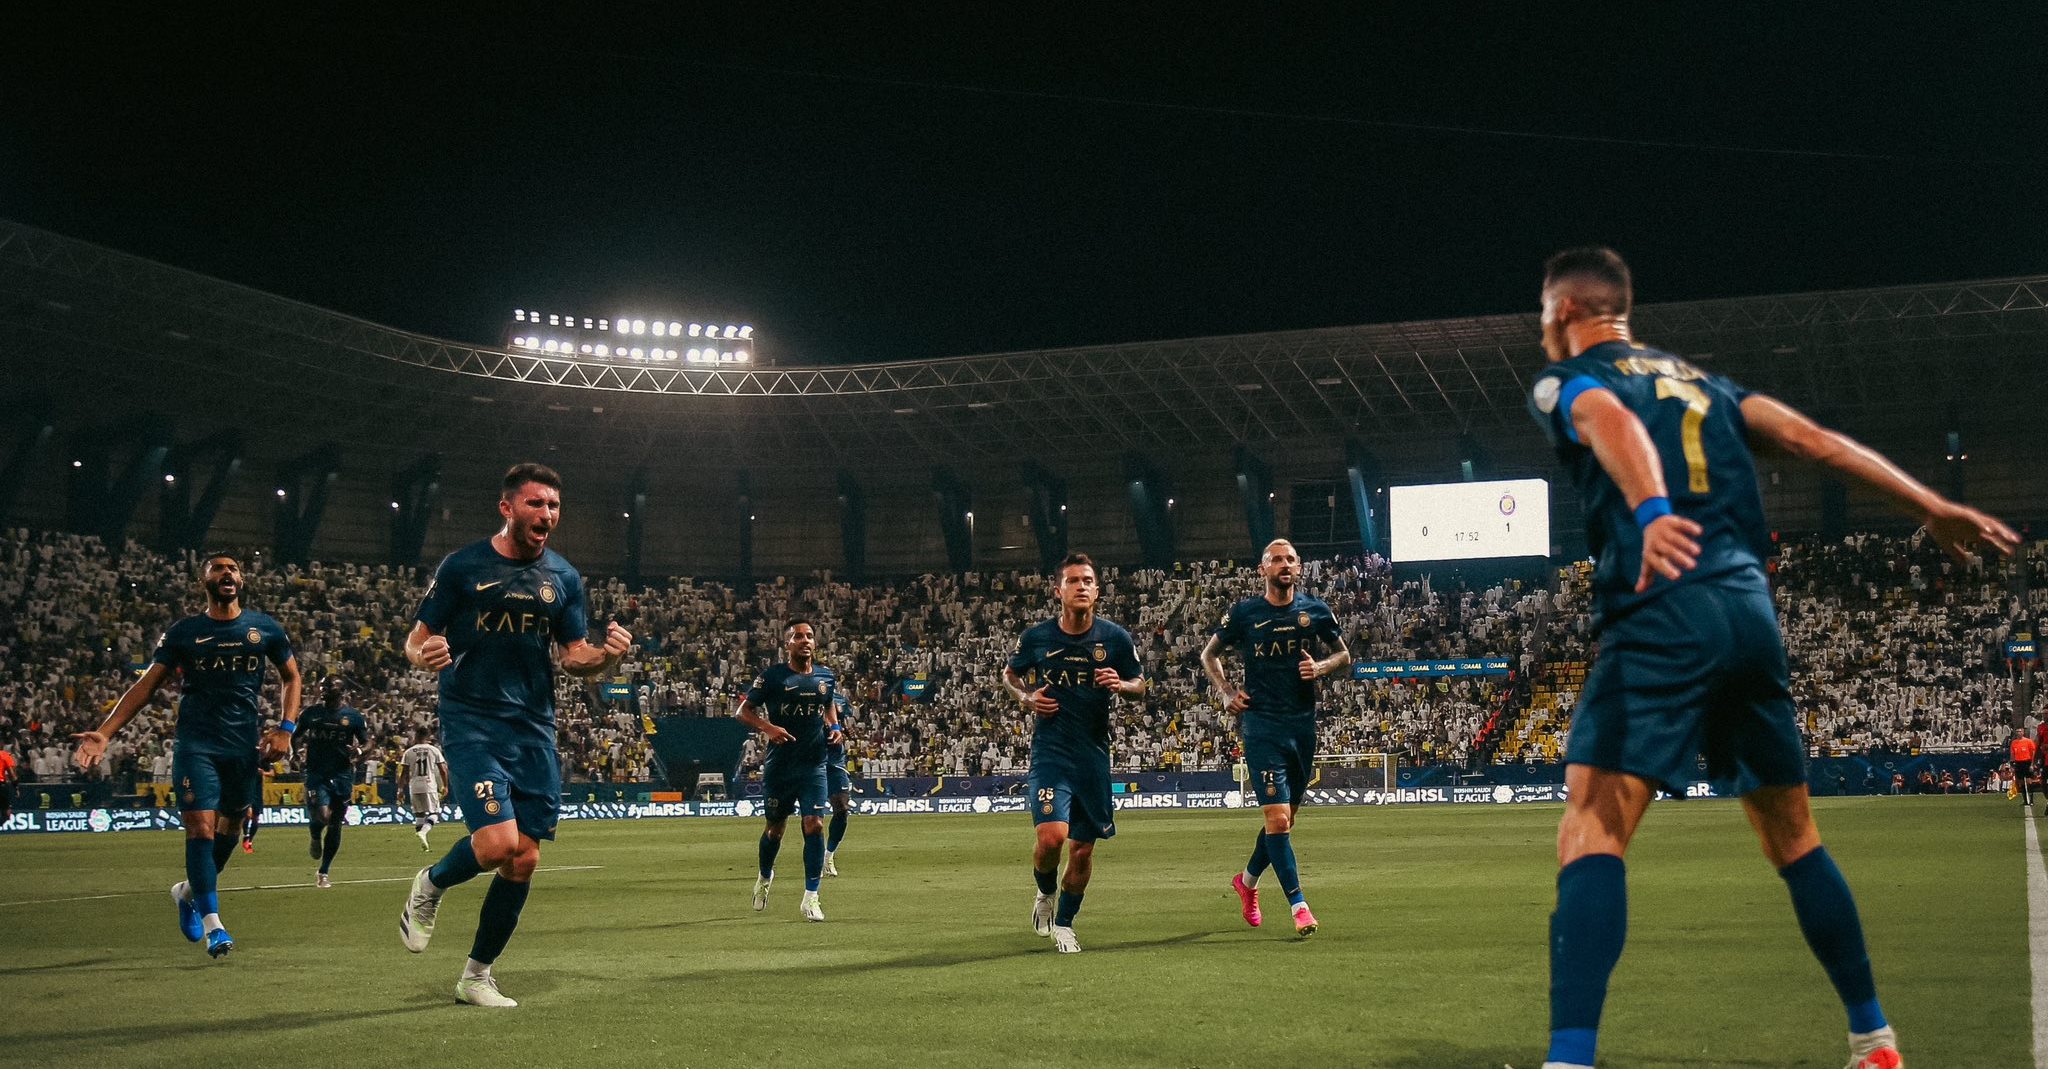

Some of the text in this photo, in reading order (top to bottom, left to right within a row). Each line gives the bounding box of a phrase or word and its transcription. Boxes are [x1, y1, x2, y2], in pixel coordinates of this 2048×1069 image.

[1655, 376, 1712, 493] 7
[1422, 526, 1428, 536] 0
[195, 655, 259, 671] KAFD
[1043, 669, 1099, 688] KAF
[416, 758, 428, 776] 11
[182, 776, 190, 788] 4
[475, 780, 494, 798] 27
[1038, 787, 1054, 801] 25
[1363, 788, 1448, 805] #yallaRSL
[1454, 794, 1491, 802] LEAGUE
[628, 803, 695, 819] #yallaRSL
[860, 799, 934, 815] #yallaRSL
[939, 804, 971, 813] LEAGUE
[1187, 799, 1222, 808] LEAGUE
[700, 808, 734, 816] LEAGUE
[46, 820, 88, 831] LEAGUE
